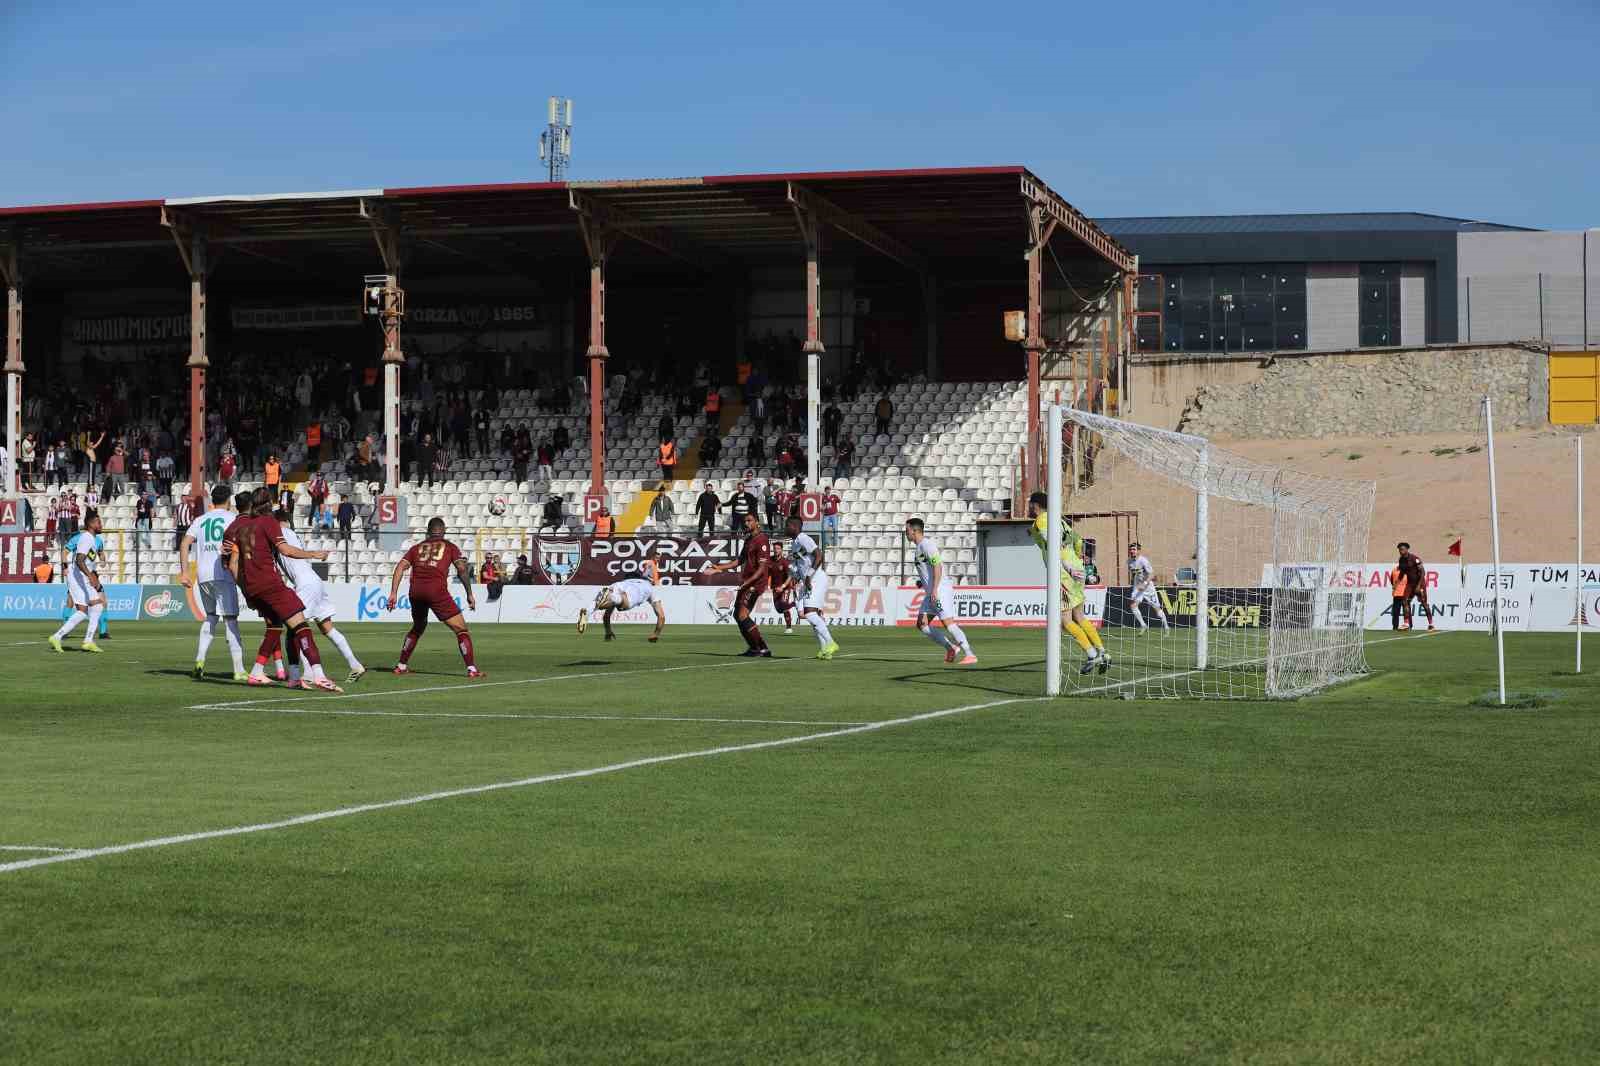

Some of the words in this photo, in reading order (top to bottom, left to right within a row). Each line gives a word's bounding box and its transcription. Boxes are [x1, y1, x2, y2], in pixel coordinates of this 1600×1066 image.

[408, 307, 459, 322] ORZA
[2, 503, 16, 523] A
[383, 501, 395, 521] S
[588, 499, 601, 520] P
[200, 517, 225, 542] 16
[1329, 570, 1439, 588] ASLANR
[1529, 566, 1569, 582] TÜM
[3, 594, 57, 611] ROYAL
[953, 601, 1003, 617] EDEF
[1380, 603, 1460, 617] AIENT
[754, 617, 801, 626] IZGAA
[823, 617, 885, 626] ZZETLER
